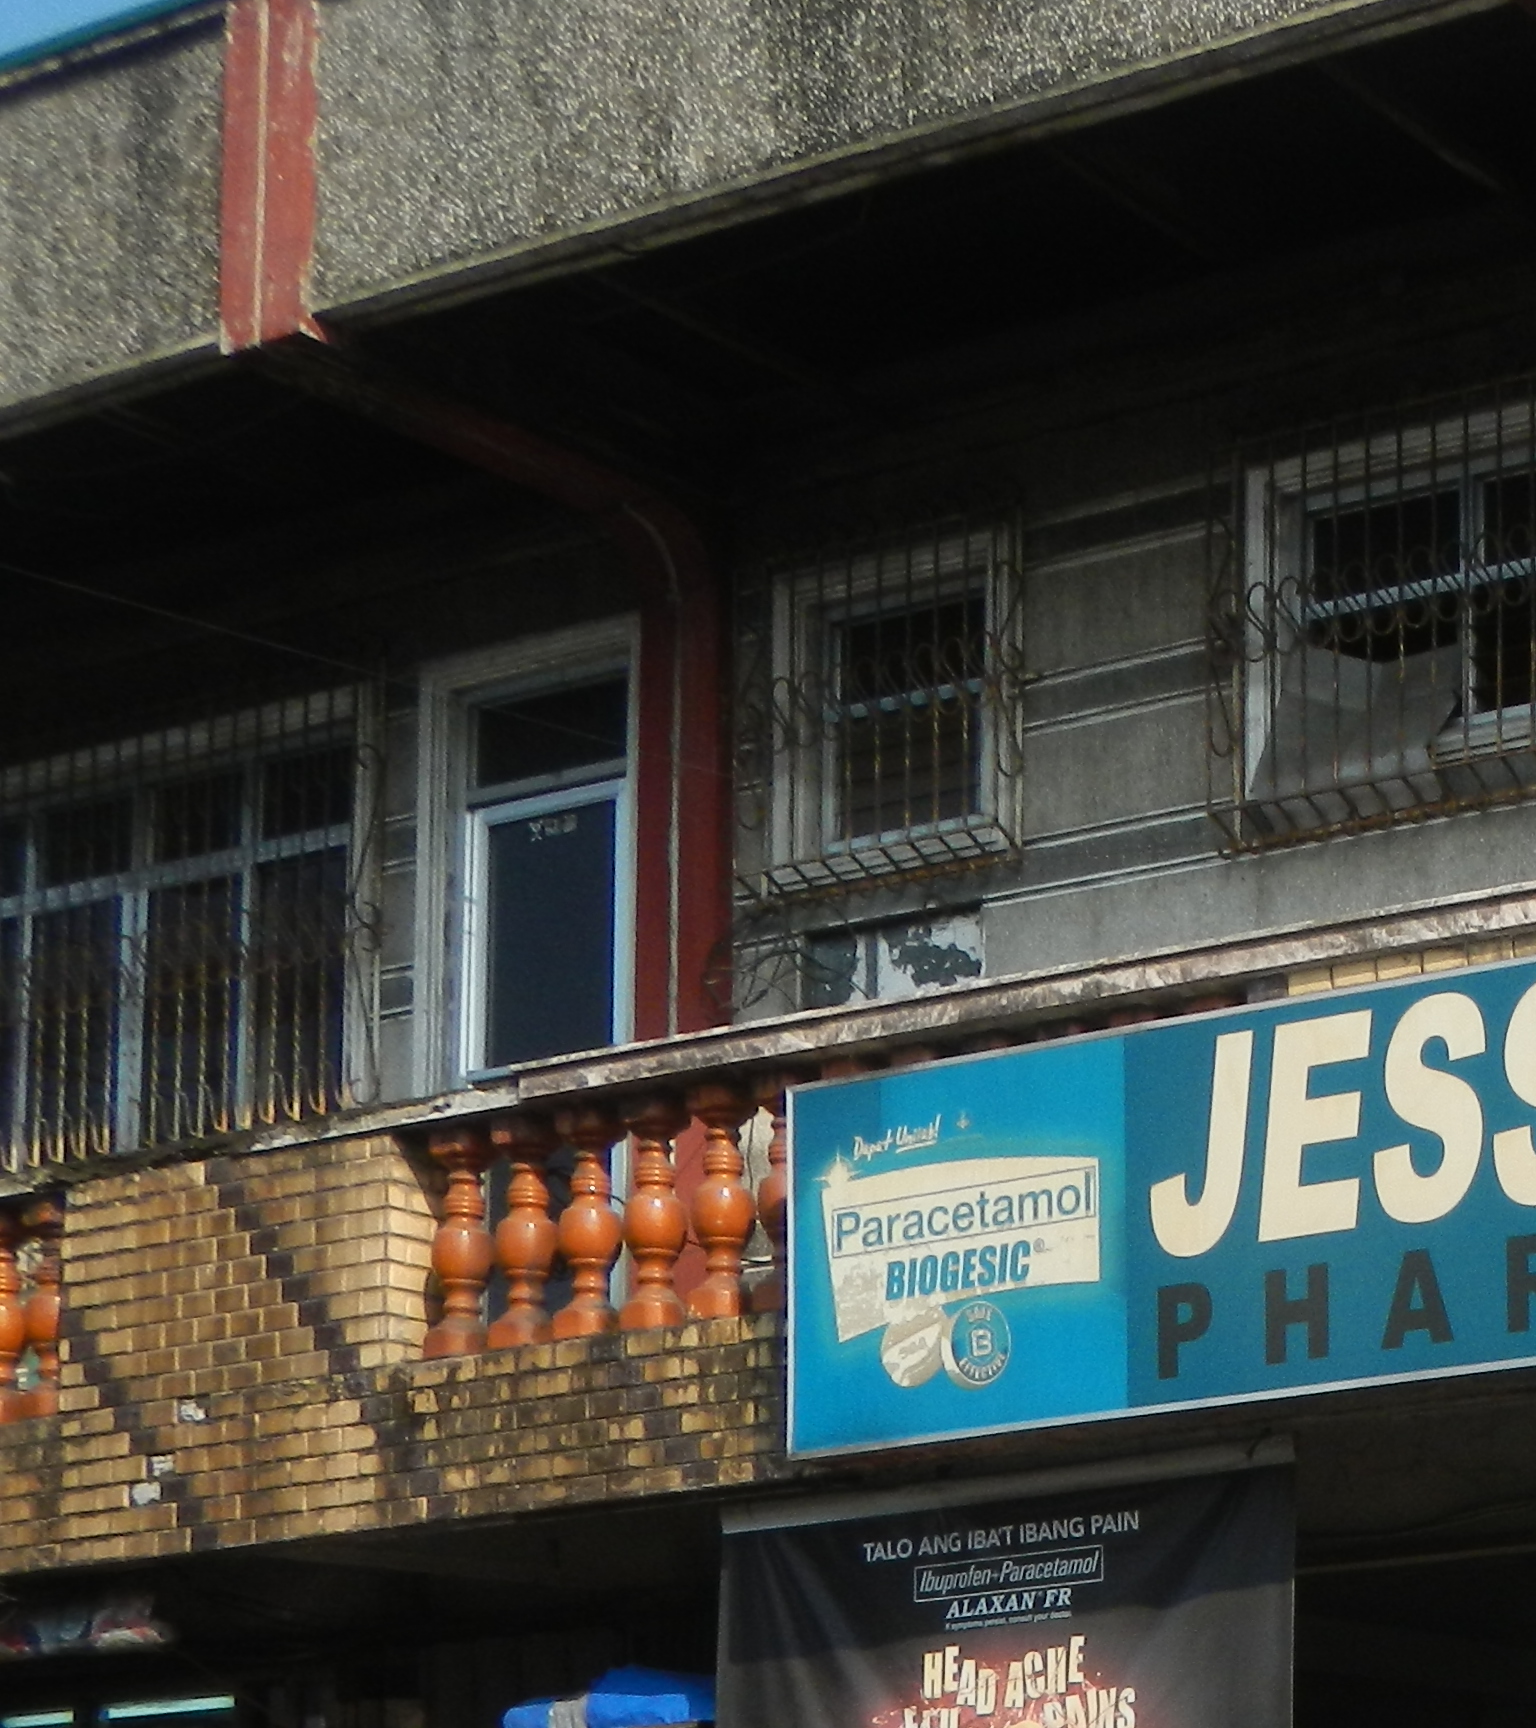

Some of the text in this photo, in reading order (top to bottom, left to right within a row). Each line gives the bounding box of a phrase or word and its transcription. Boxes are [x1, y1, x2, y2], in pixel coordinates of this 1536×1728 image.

[836, 1170, 1092, 1251] Paracetamol
[863, 1538, 914, 1563] TALO
[918, 1532, 962, 1557] ANG
[1018, 1516, 1086, 1544] IBANG
[1089, 1510, 1140, 1536] PAIN
[944, 1587, 1073, 1619] ALAXAN FR
[920, 1634, 1087, 1716] HEAD ACHE
